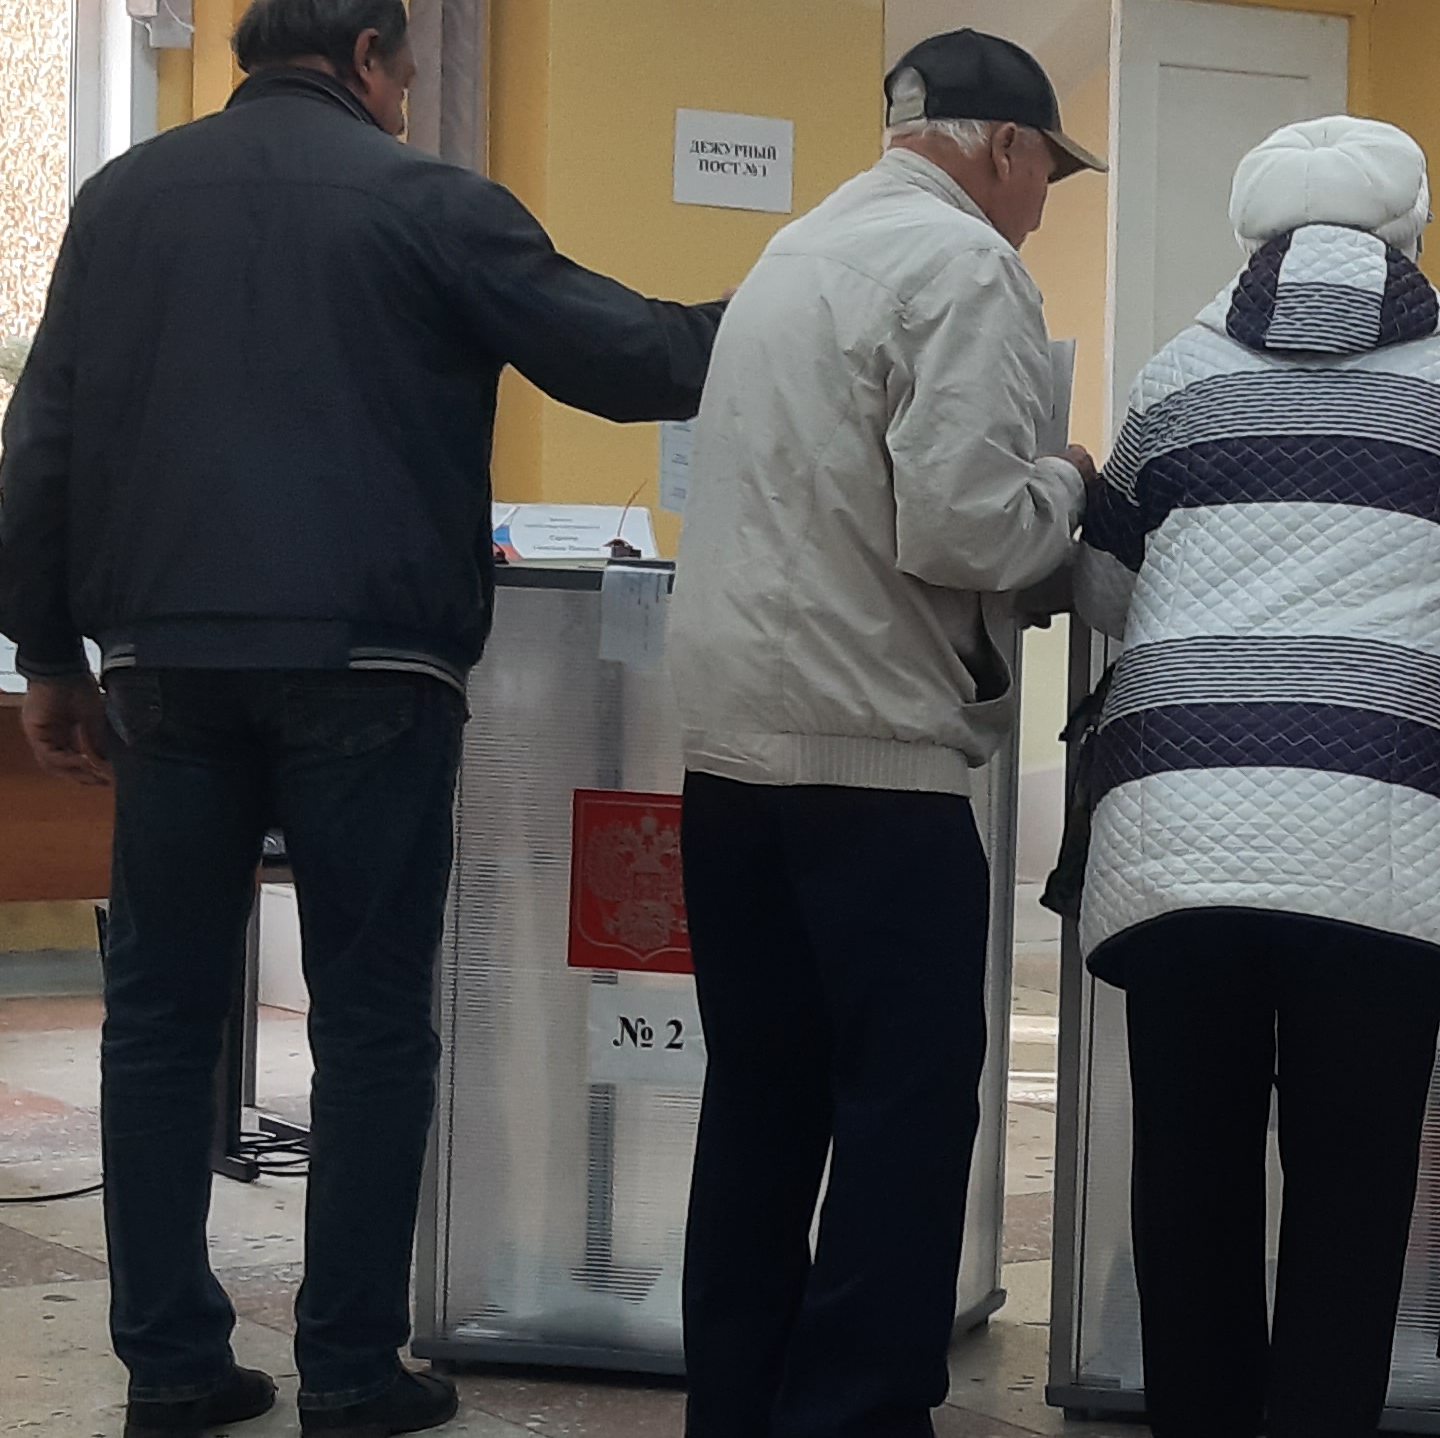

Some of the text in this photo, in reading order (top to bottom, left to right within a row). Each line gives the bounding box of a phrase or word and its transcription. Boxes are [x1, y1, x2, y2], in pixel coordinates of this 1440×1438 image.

[689, 140, 777, 161] ДЕЖУРНЫЙ
[699, 158, 740, 175] ПОСТ
[613, 1016, 684, 1051] № 2
